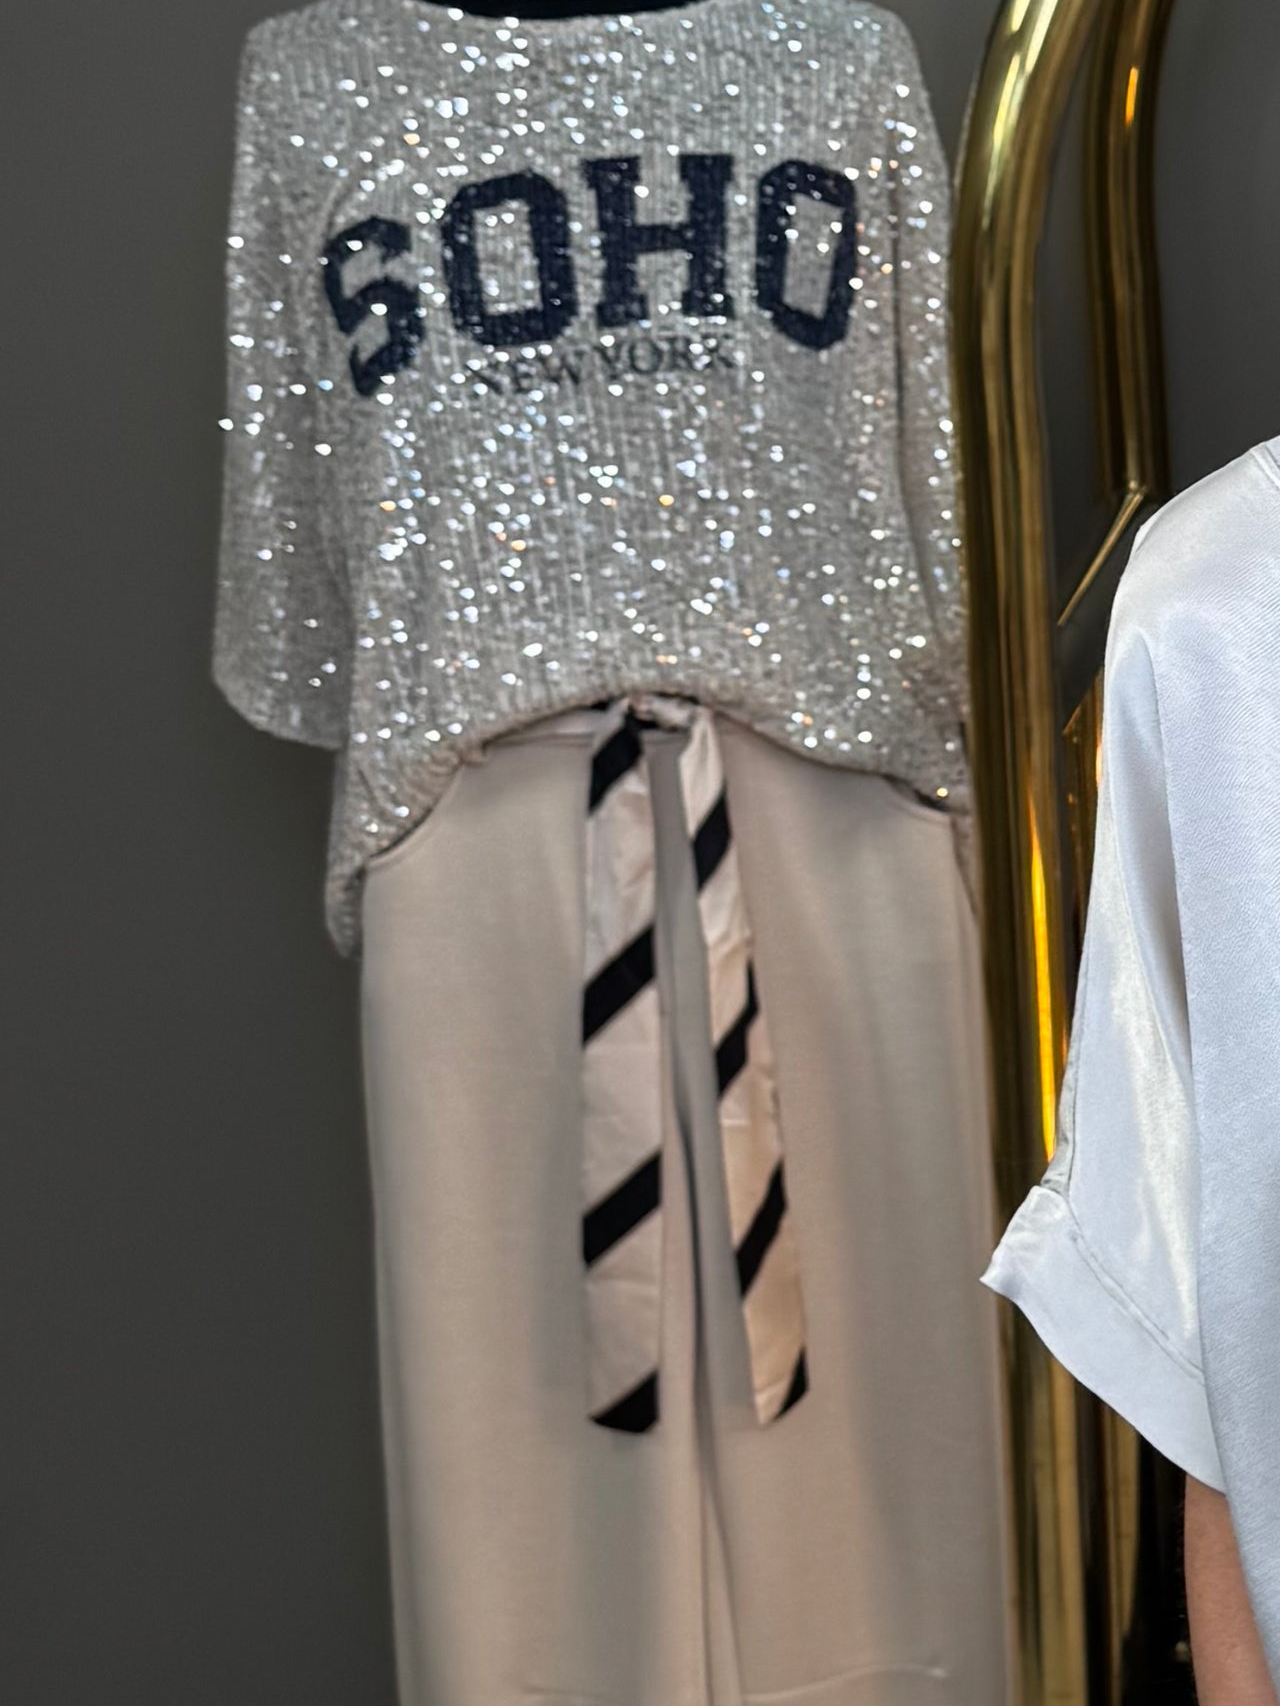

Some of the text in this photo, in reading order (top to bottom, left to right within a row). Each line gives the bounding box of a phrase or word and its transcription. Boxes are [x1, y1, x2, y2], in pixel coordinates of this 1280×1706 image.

[322, 153, 858, 395] SOHO
[465, 332, 734, 395] NEW YORK
